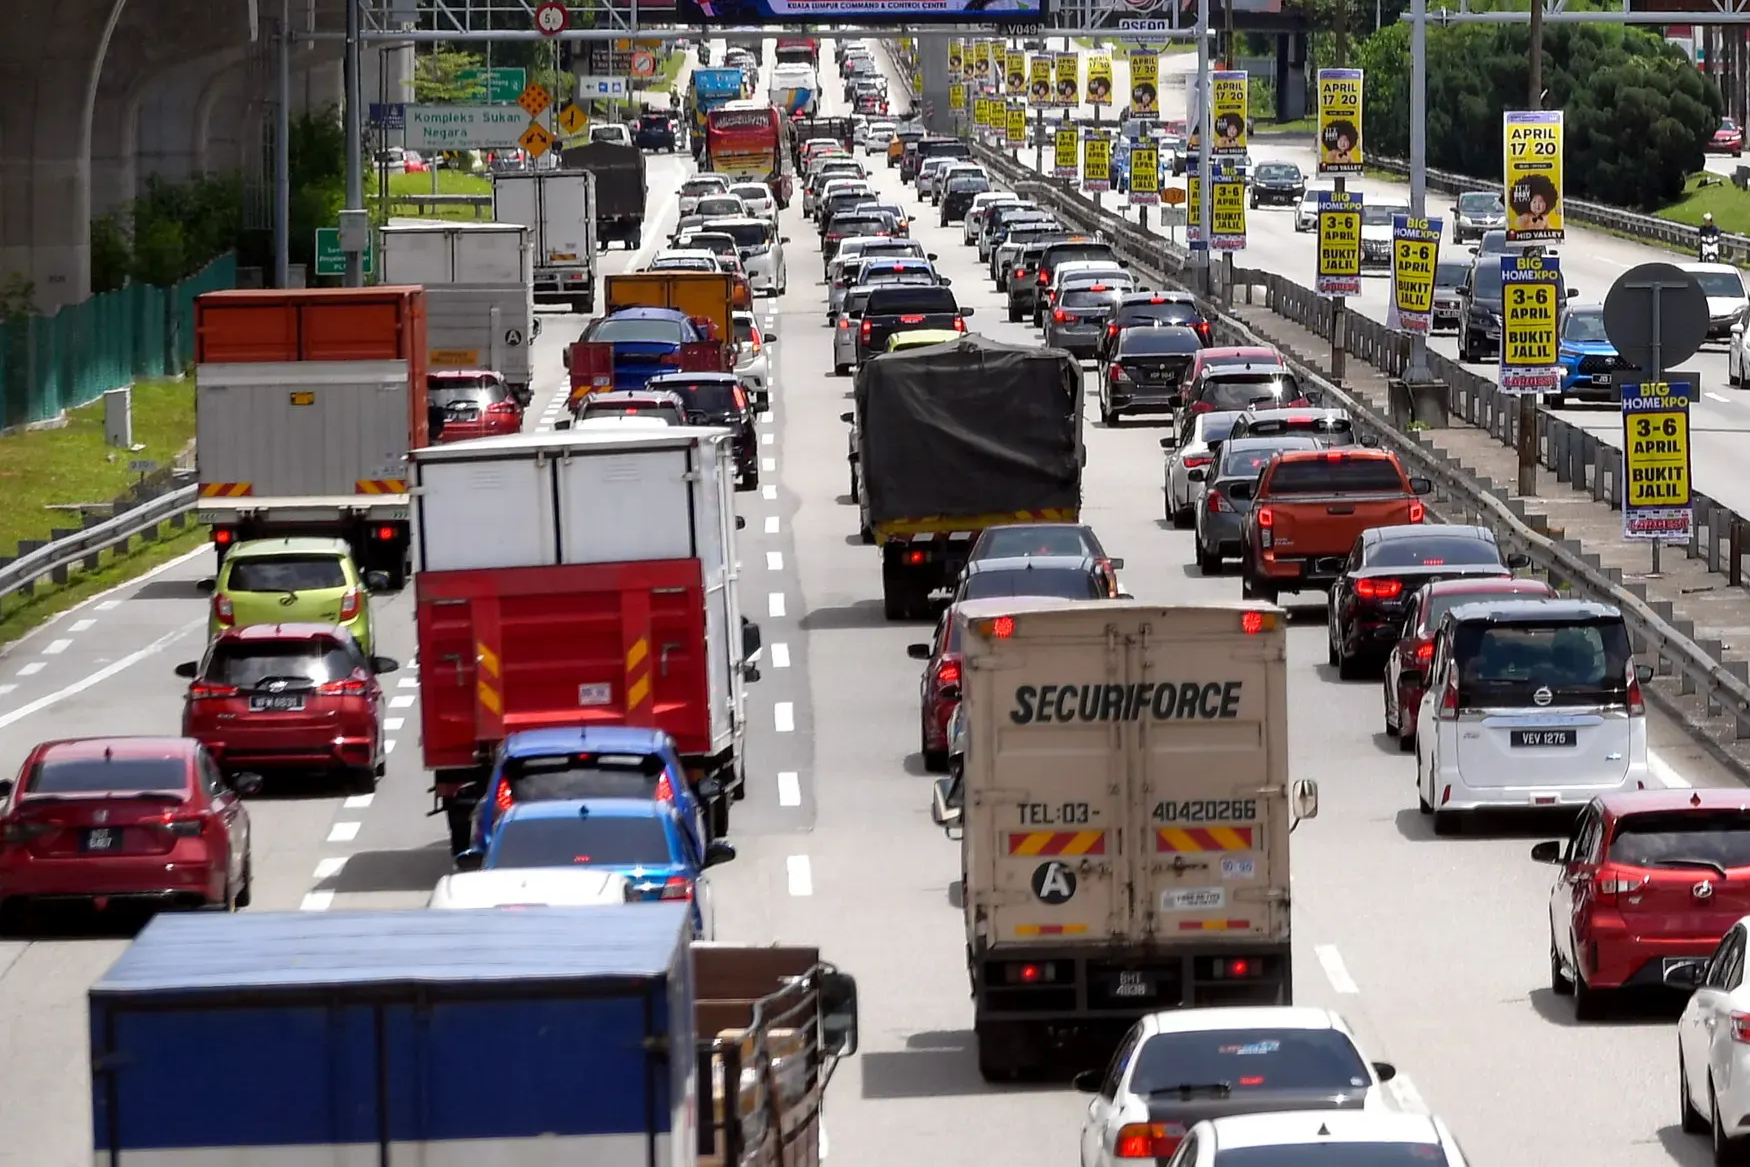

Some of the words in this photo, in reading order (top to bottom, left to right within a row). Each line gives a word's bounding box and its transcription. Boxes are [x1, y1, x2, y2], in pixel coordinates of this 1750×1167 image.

[1216, 82, 1243, 91] APRIL
[1323, 83, 1357, 92] APRIL
[1216, 92, 1226, 101] 17
[1231, 92, 1243, 101] 20
[1323, 94, 1334, 105] 17
[1341, 94, 1357, 105] 20
[414, 111, 476, 125] Kompleks
[482, 111, 521, 123] Sukan
[423, 127, 468, 139] Negara
[1511, 128, 1556, 139] APRIL
[1510, 142, 1526, 155] 17
[1534, 142, 1556, 155] 20
[1330, 193, 1351, 202] BIG
[1319, 202, 1362, 210] HOMEXPO
[1327, 216, 1353, 229] 3-6
[1407, 218, 1428, 229] BIG
[1325, 231, 1355, 240] APRIL
[1394, 228, 1439, 239] HOMEXPO
[1533, 231, 1562, 239] VALLEY
[1323, 249, 1356, 259] BUKIT
[1400, 245, 1429, 260] 3-6
[1325, 260, 1354, 270] JALIL
[1399, 261, 1431, 273] APRIL
[1517, 257, 1542, 269] BIG
[1502, 270, 1558, 281] HOMEXPO
[1398, 281, 1430, 293] BUKIT
[1400, 293, 1425, 306] JALIL
[1513, 288, 1548, 304] 3-6
[1510, 307, 1551, 320] APRIL
[1509, 330, 1552, 343] BUKIT
[1511, 345, 1550, 358] JALIL
[1640, 382, 1670, 396] BIG
[1623, 397, 1688, 409] HOMEXPO
[1636, 418, 1677, 437] 3-6
[1634, 440, 1681, 453] APRIL
[1632, 466, 1684, 482] BUKIT
[1636, 483, 1681, 498] JALIL
[1009, 681, 1242, 725] SECURIFORCE
[1522, 732, 1540, 744] VEV
[1152, 800, 1256, 822] 40420266
[1039, 862, 1071, 898] A
